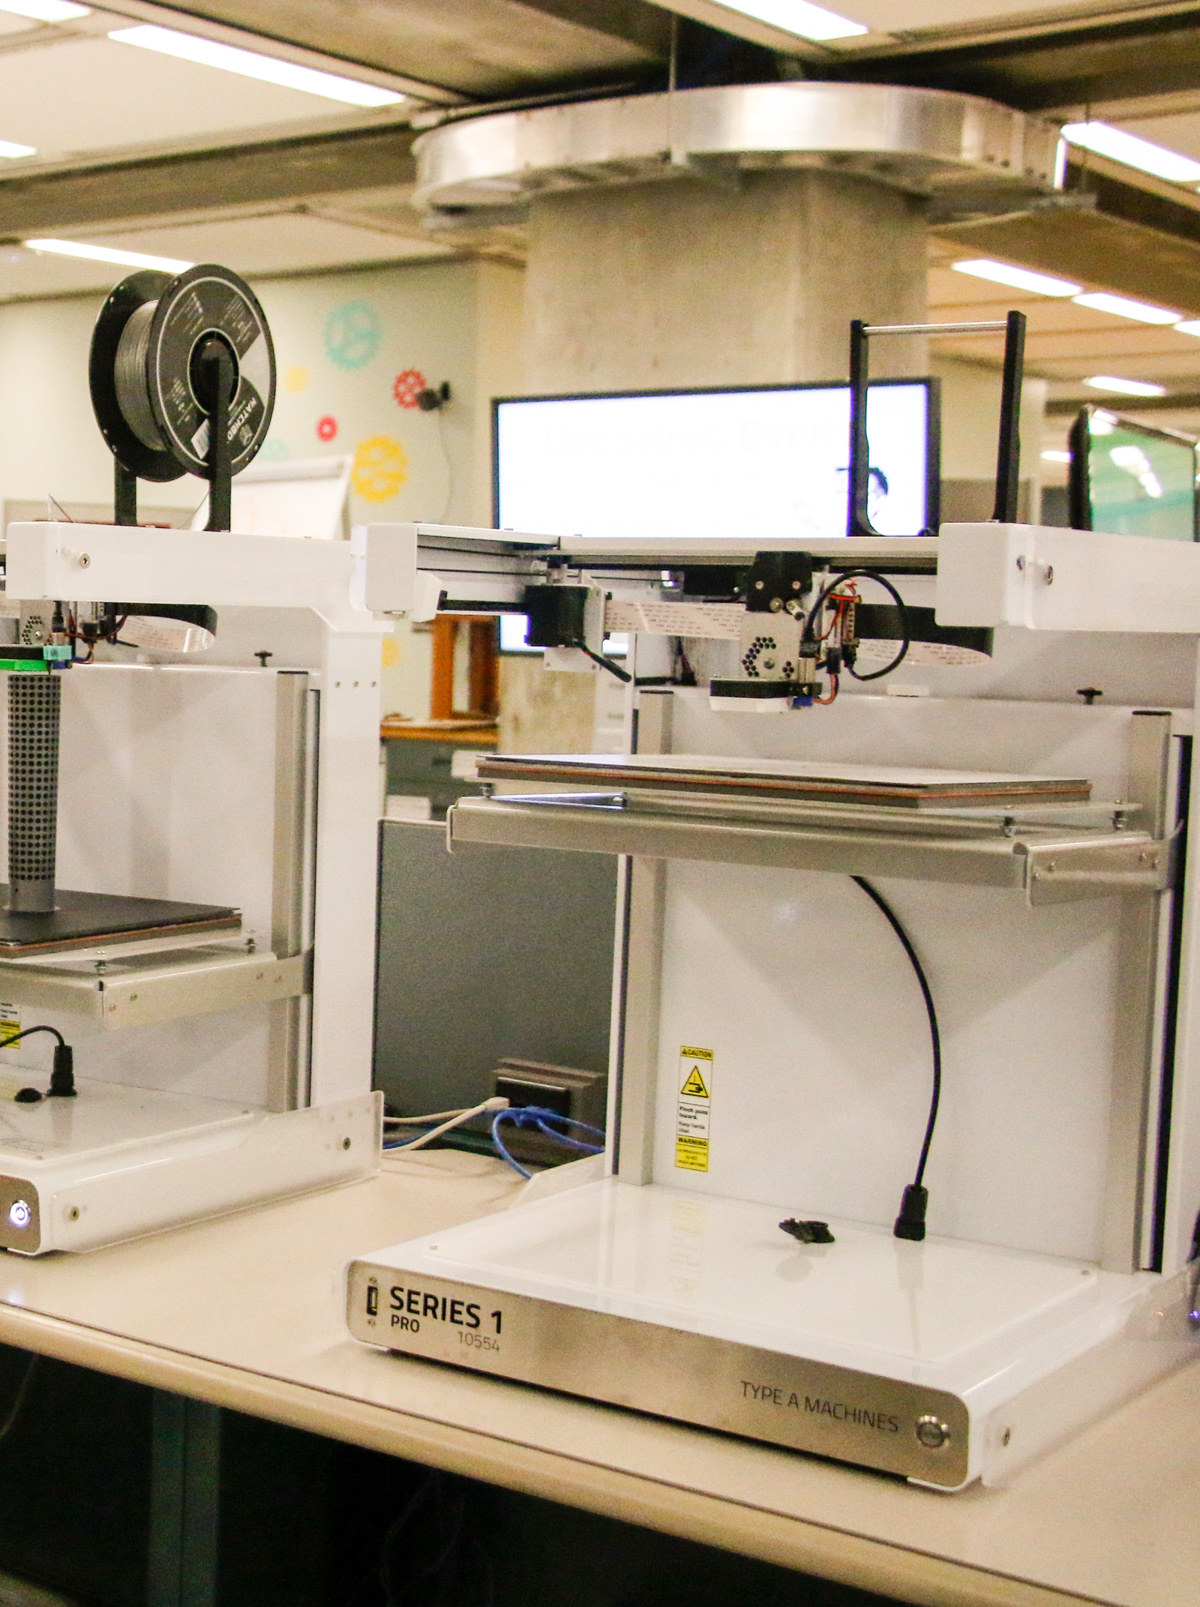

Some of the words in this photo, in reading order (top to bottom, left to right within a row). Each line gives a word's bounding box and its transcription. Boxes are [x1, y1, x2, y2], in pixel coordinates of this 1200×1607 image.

[226, 397, 257, 442] HATCHBO
[678, 1137, 707, 1147] WARNING
[390, 1286, 481, 1329] SERIES
[491, 1310, 502, 1334] 1
[391, 1314, 420, 1333] PRO
[457, 1331, 500, 1352] 10554
[740, 1381, 783, 1405] TYPE
[787, 1392, 799, 1409] A
[804, 1396, 899, 1433] MACHINES
